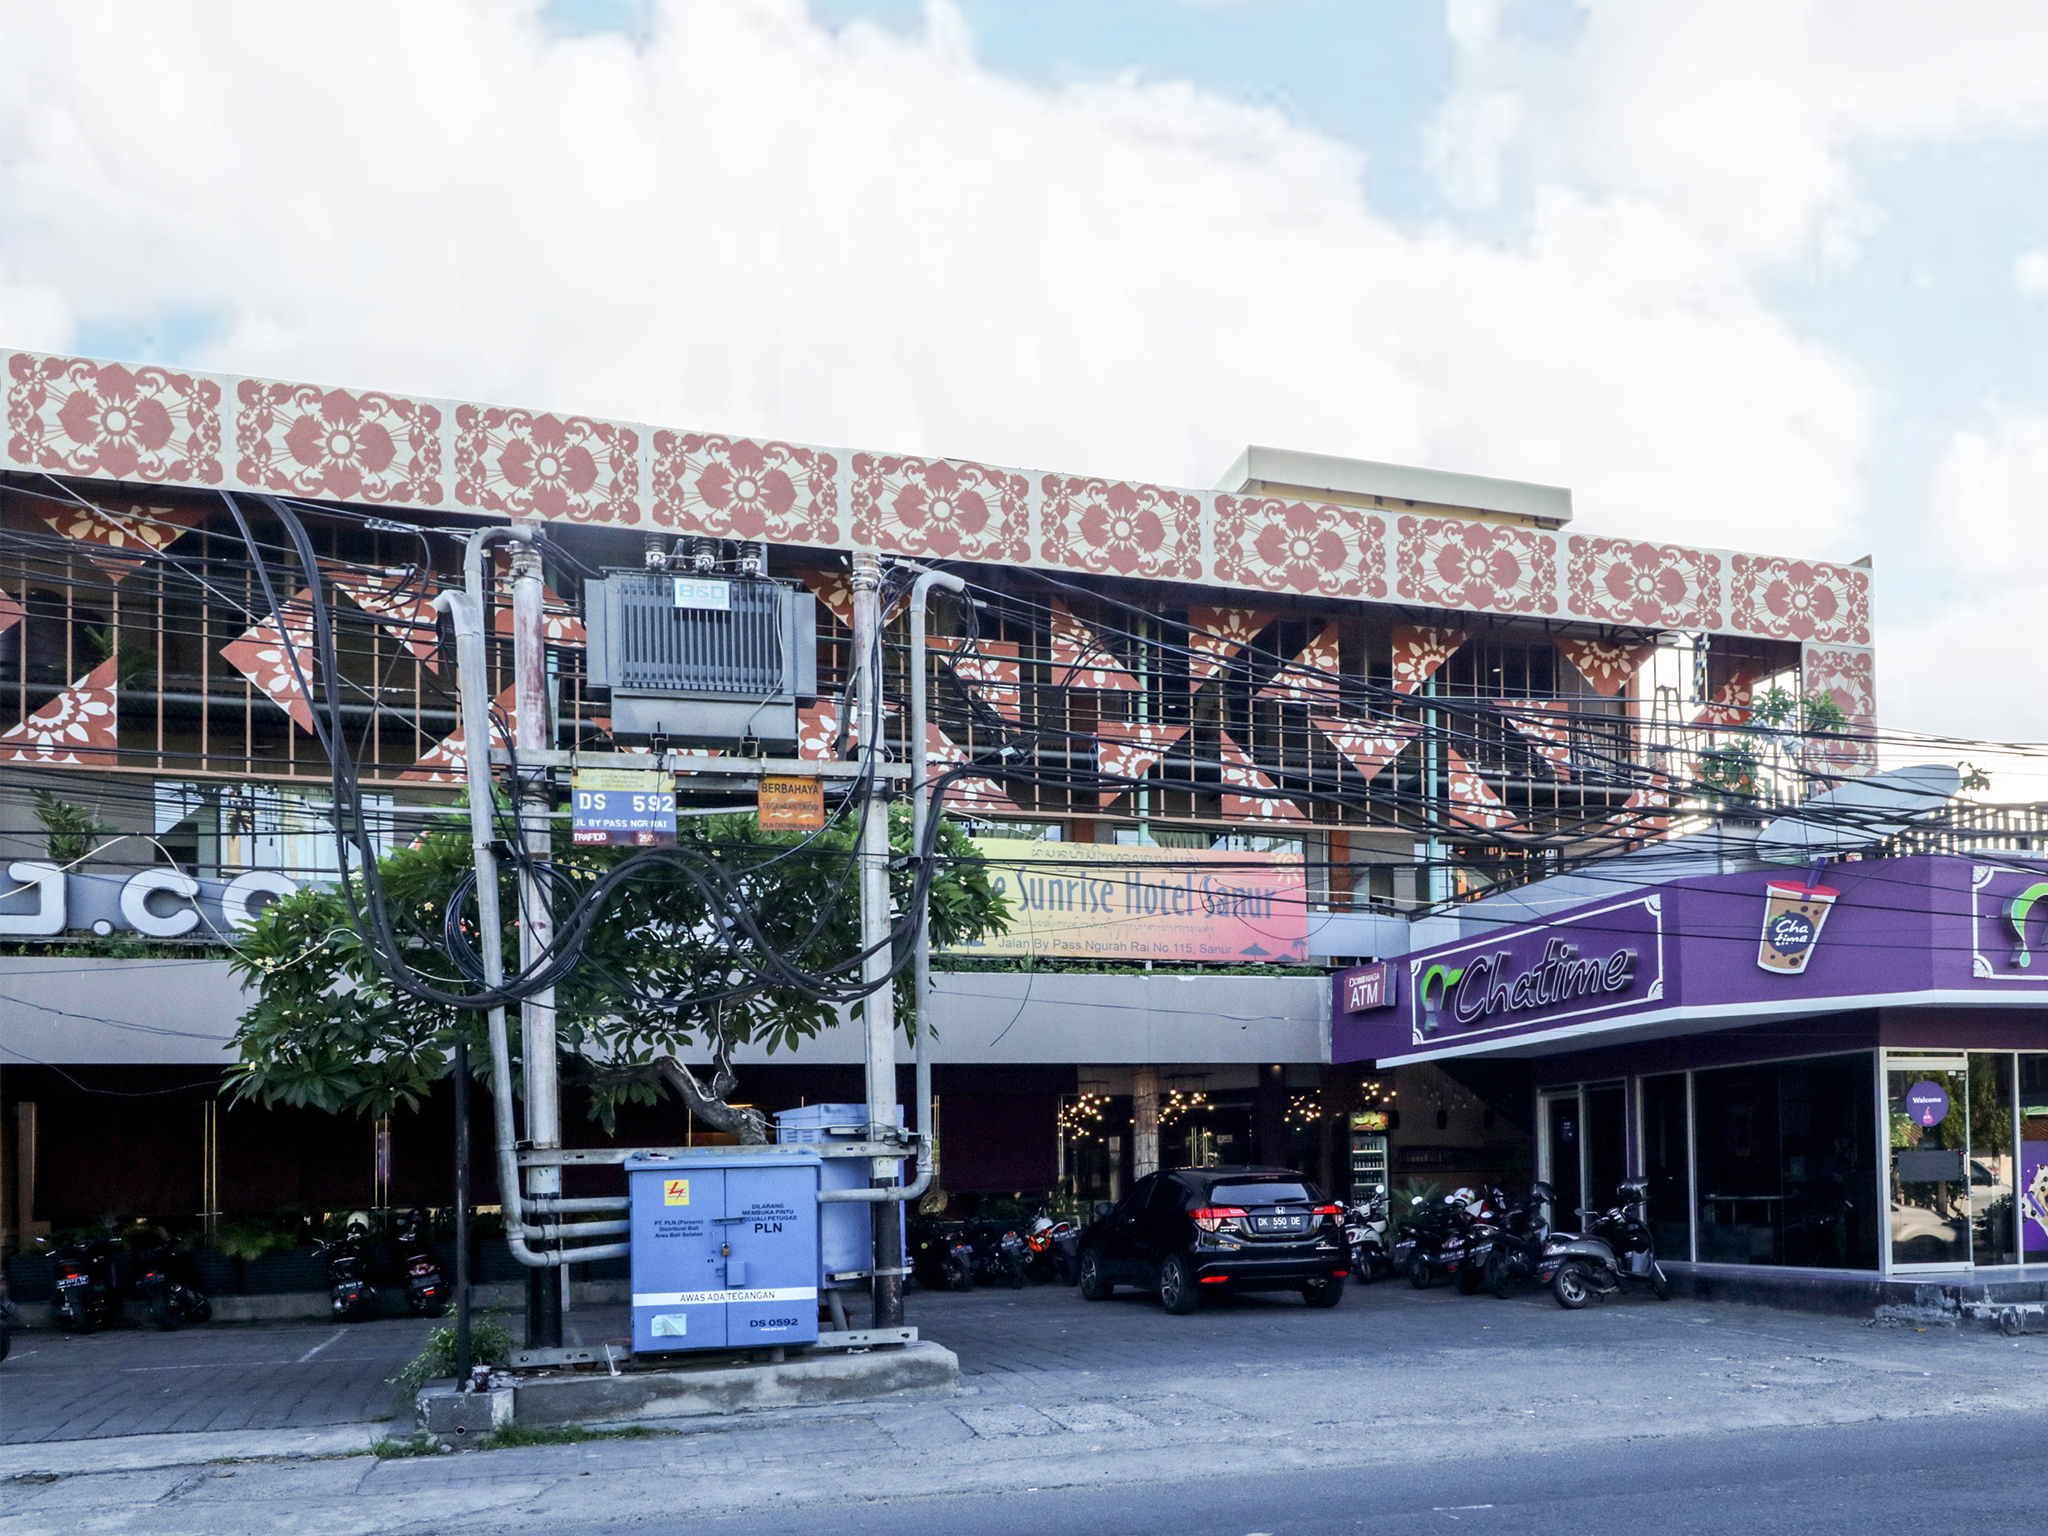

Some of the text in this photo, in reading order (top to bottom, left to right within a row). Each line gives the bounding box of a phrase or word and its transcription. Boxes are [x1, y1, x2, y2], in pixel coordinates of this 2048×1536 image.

[761, 783, 819, 795] BERBAHAYA
[579, 792, 674, 812] DS 592
[575, 819, 667, 828] JL BY PASS NGR RAI
[1017, 866, 1114, 914] Sunrise
[1125, 871, 1193, 917] Hotel
[1202, 875, 1278, 919] Sanur
[1775, 919, 1809, 933] Cha
[1773, 933, 1808, 946] time
[999, 938, 1030, 949] Jalan
[1034, 938, 1049, 950] By
[1053, 939, 1082, 950] Pass
[1086, 940, 1127, 953] Ngurah
[1131, 942, 1149, 952] Rai
[1200, 944, 1232, 955] Sanur
[1454, 937, 1633, 1024] Chatime
[1350, 982, 1379, 1008] ATM
[754, 1222, 783, 1233] PLN
[1258, 1216, 1301, 1226] DK 550 DE
[679, 1291, 775, 1302] AWAS ADA TEGANGAN
[750, 1318, 798, 1328] DS 0592
